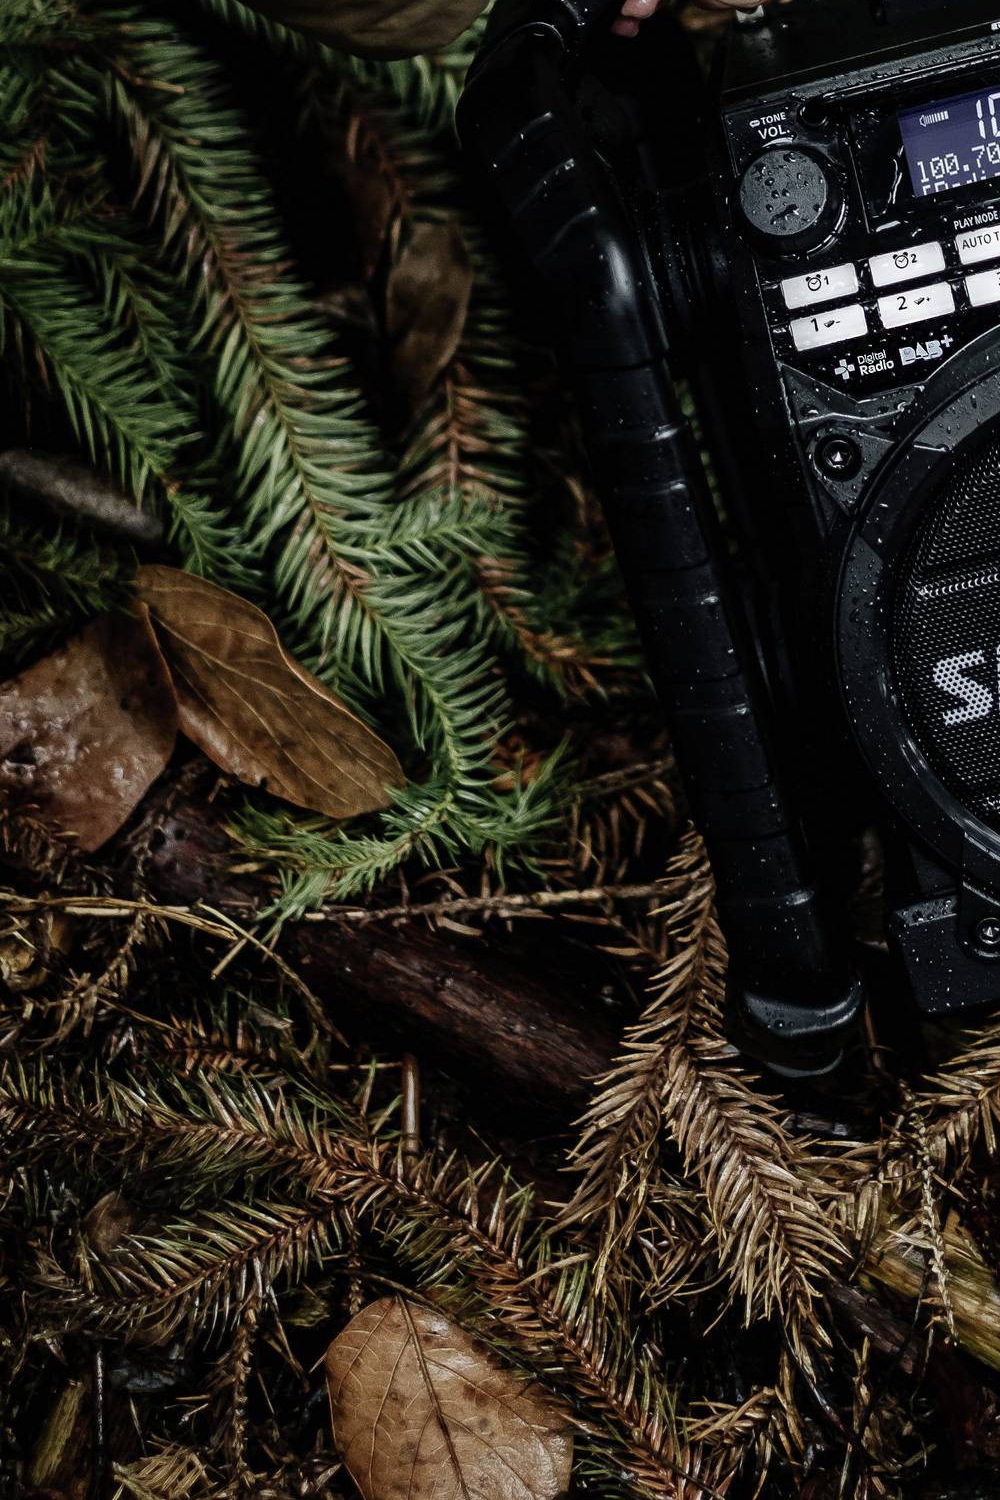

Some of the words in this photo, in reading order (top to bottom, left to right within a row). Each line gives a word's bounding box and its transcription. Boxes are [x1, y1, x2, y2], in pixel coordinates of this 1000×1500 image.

[760, 112, 786, 125] TONE
[953, 216, 974, 230] PLAY
[962, 233, 992, 250] AUTO
[911, 253, 918, 263] 2
[824, 275, 830, 285] 1
[897, 296, 908, 310] 2
[811, 318, 819, 332] 1
[857, 349, 887, 365] Digital
[859, 359, 895, 376] Radio
